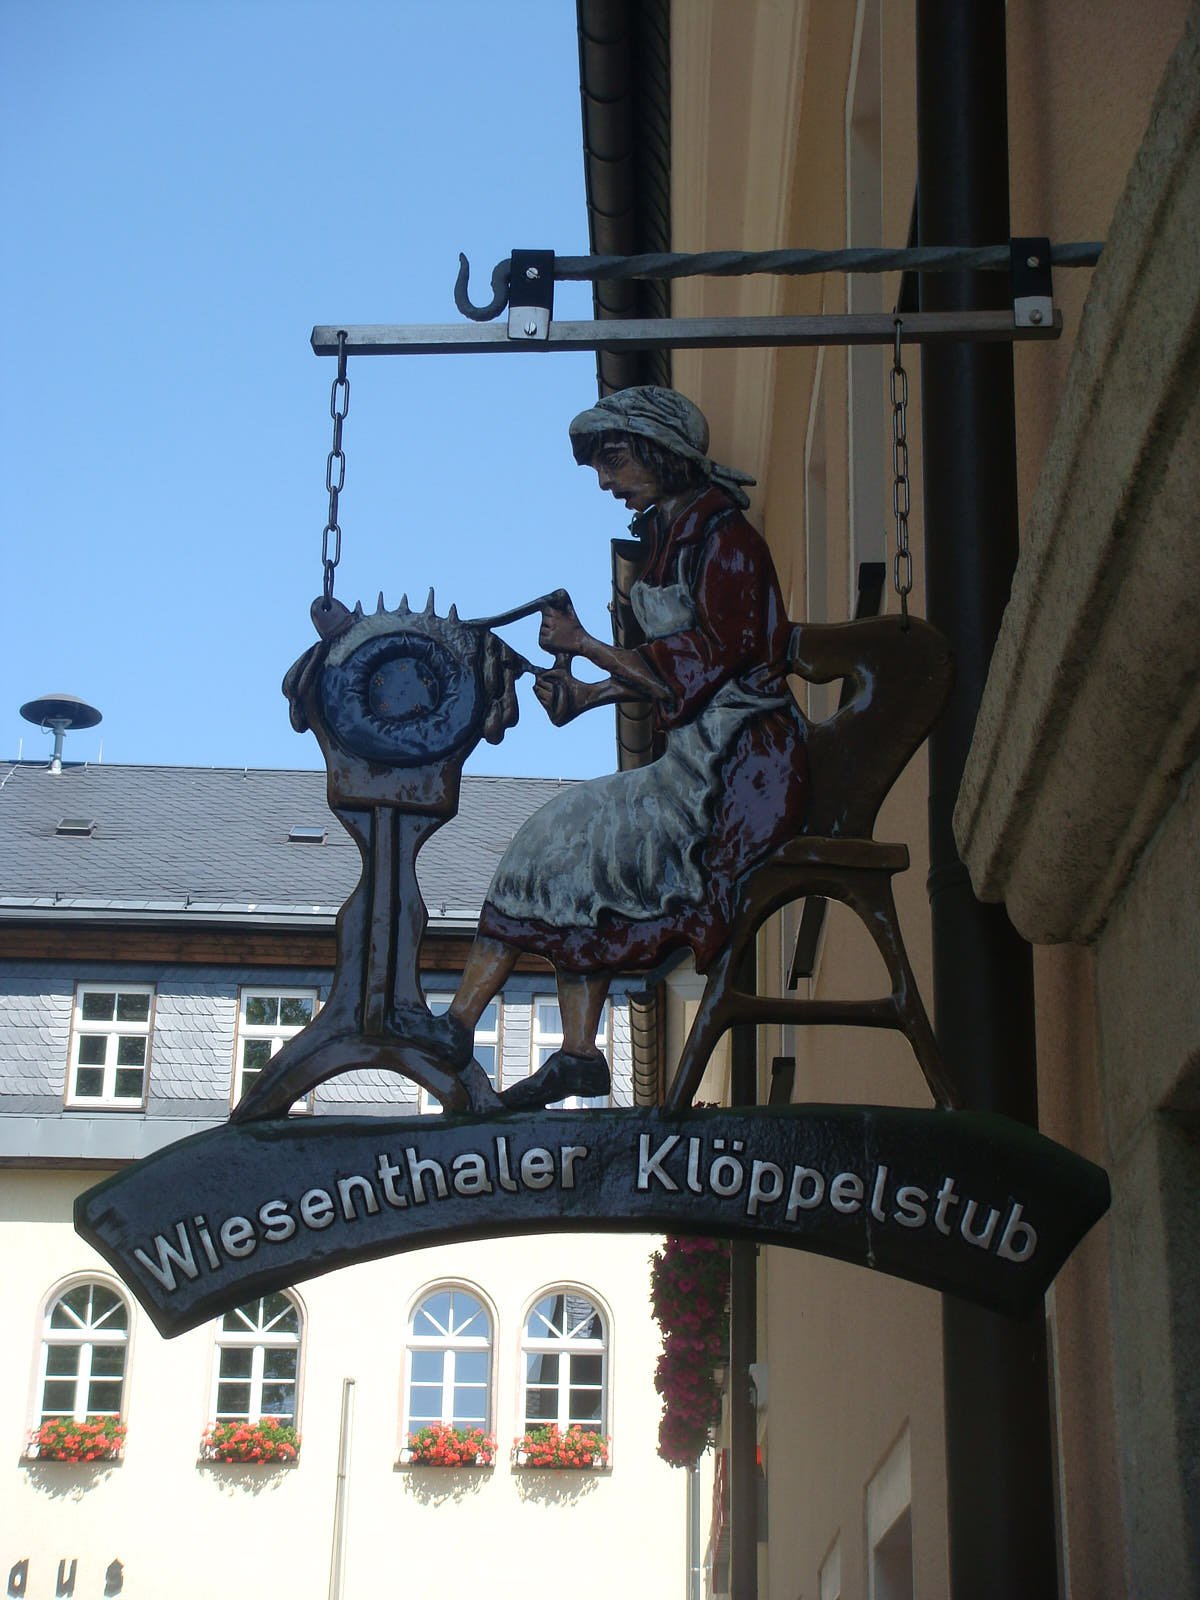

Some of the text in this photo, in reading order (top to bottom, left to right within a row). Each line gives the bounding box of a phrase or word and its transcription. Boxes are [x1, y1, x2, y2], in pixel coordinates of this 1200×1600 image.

[134, 1133, 1038, 1292] Wiesenthaler Klöppelstub
[7, 1558, 125, 1599] aus
